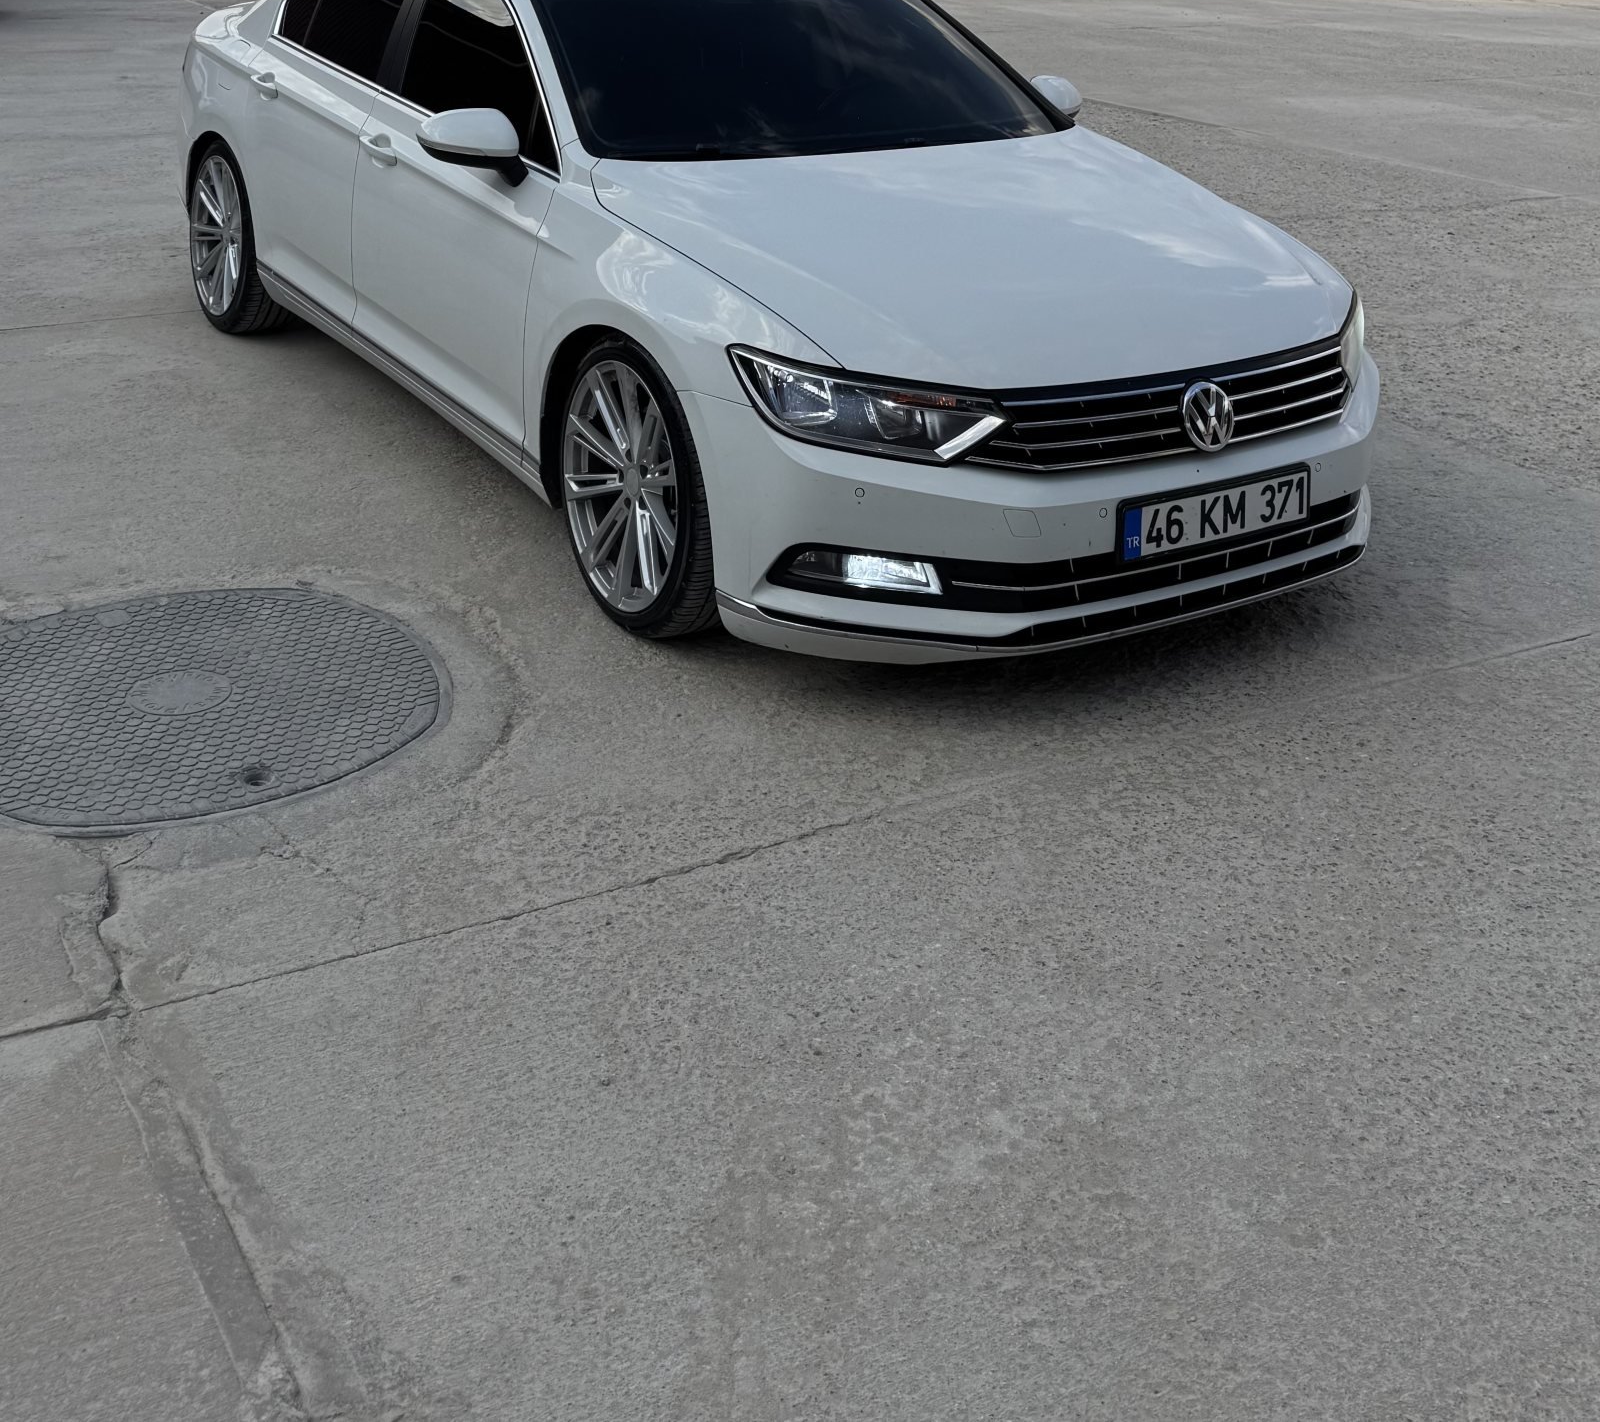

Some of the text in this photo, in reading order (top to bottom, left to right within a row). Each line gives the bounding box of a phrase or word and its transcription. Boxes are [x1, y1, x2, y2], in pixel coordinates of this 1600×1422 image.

[1185, 384, 1232, 450] VW
[1126, 536, 1140, 549] TR
[1146, 476, 1305, 548] 46 KM 371
